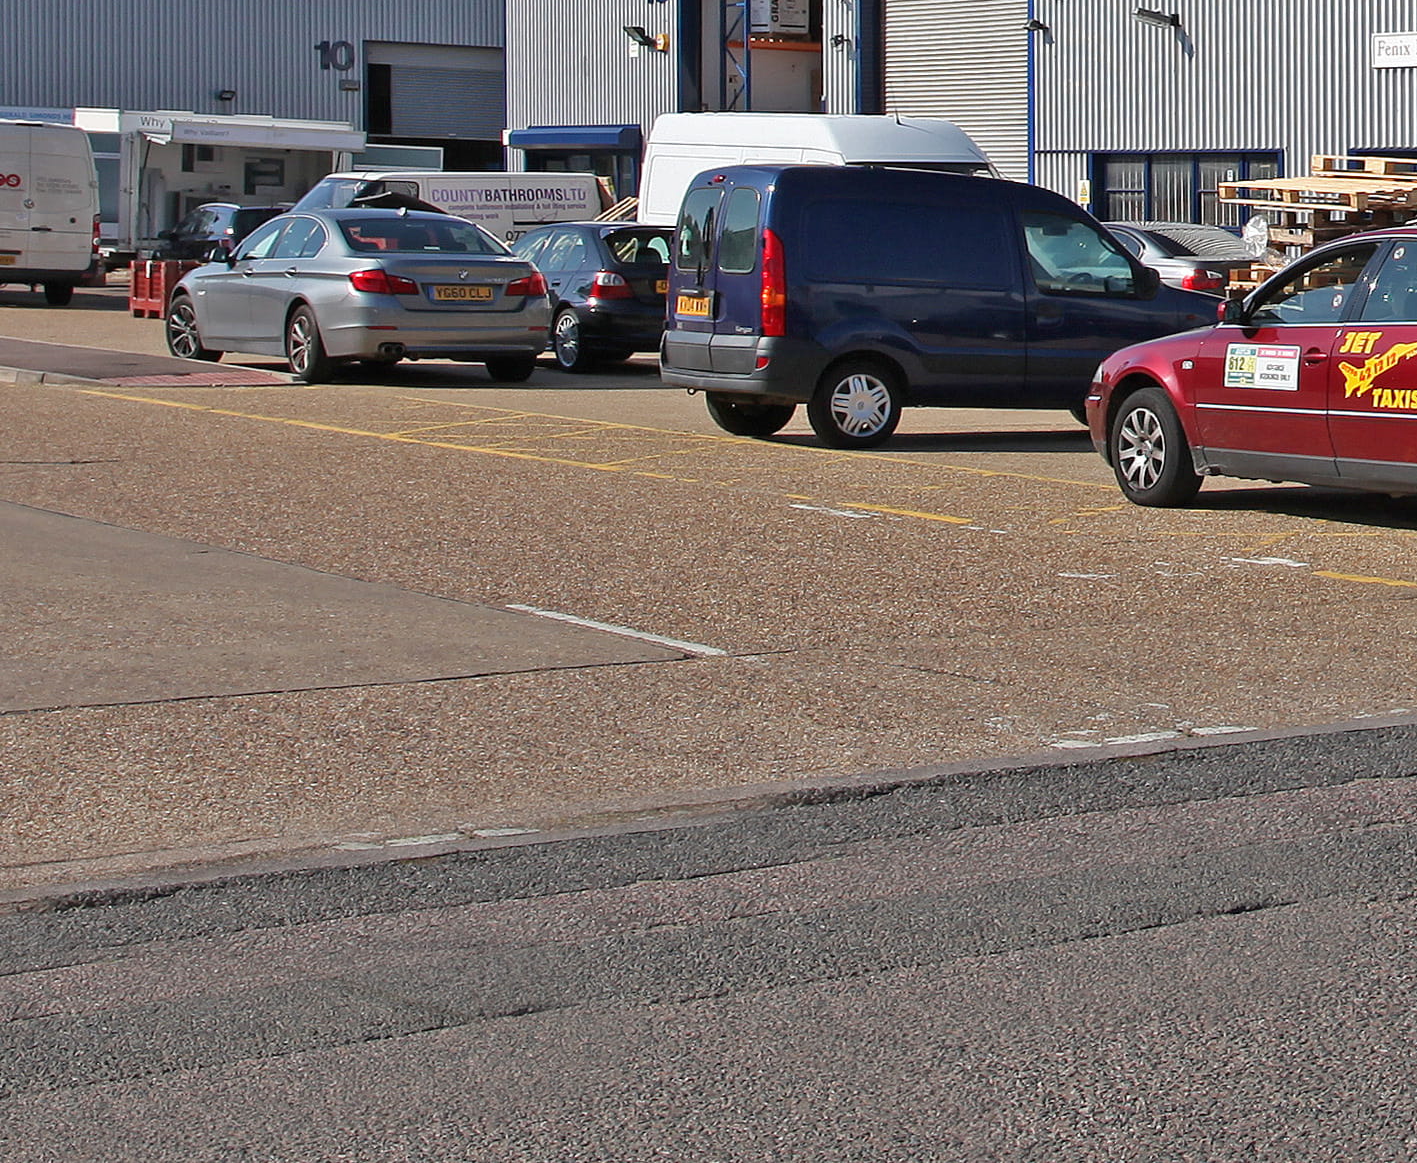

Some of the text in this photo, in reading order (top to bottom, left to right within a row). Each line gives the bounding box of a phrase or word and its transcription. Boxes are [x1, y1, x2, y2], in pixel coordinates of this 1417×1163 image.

[314, 40, 354, 71] 10
[1377, 40, 1410, 56] Fenix
[140, 116, 165, 128] Why
[1339, 331, 1383, 354] JET
